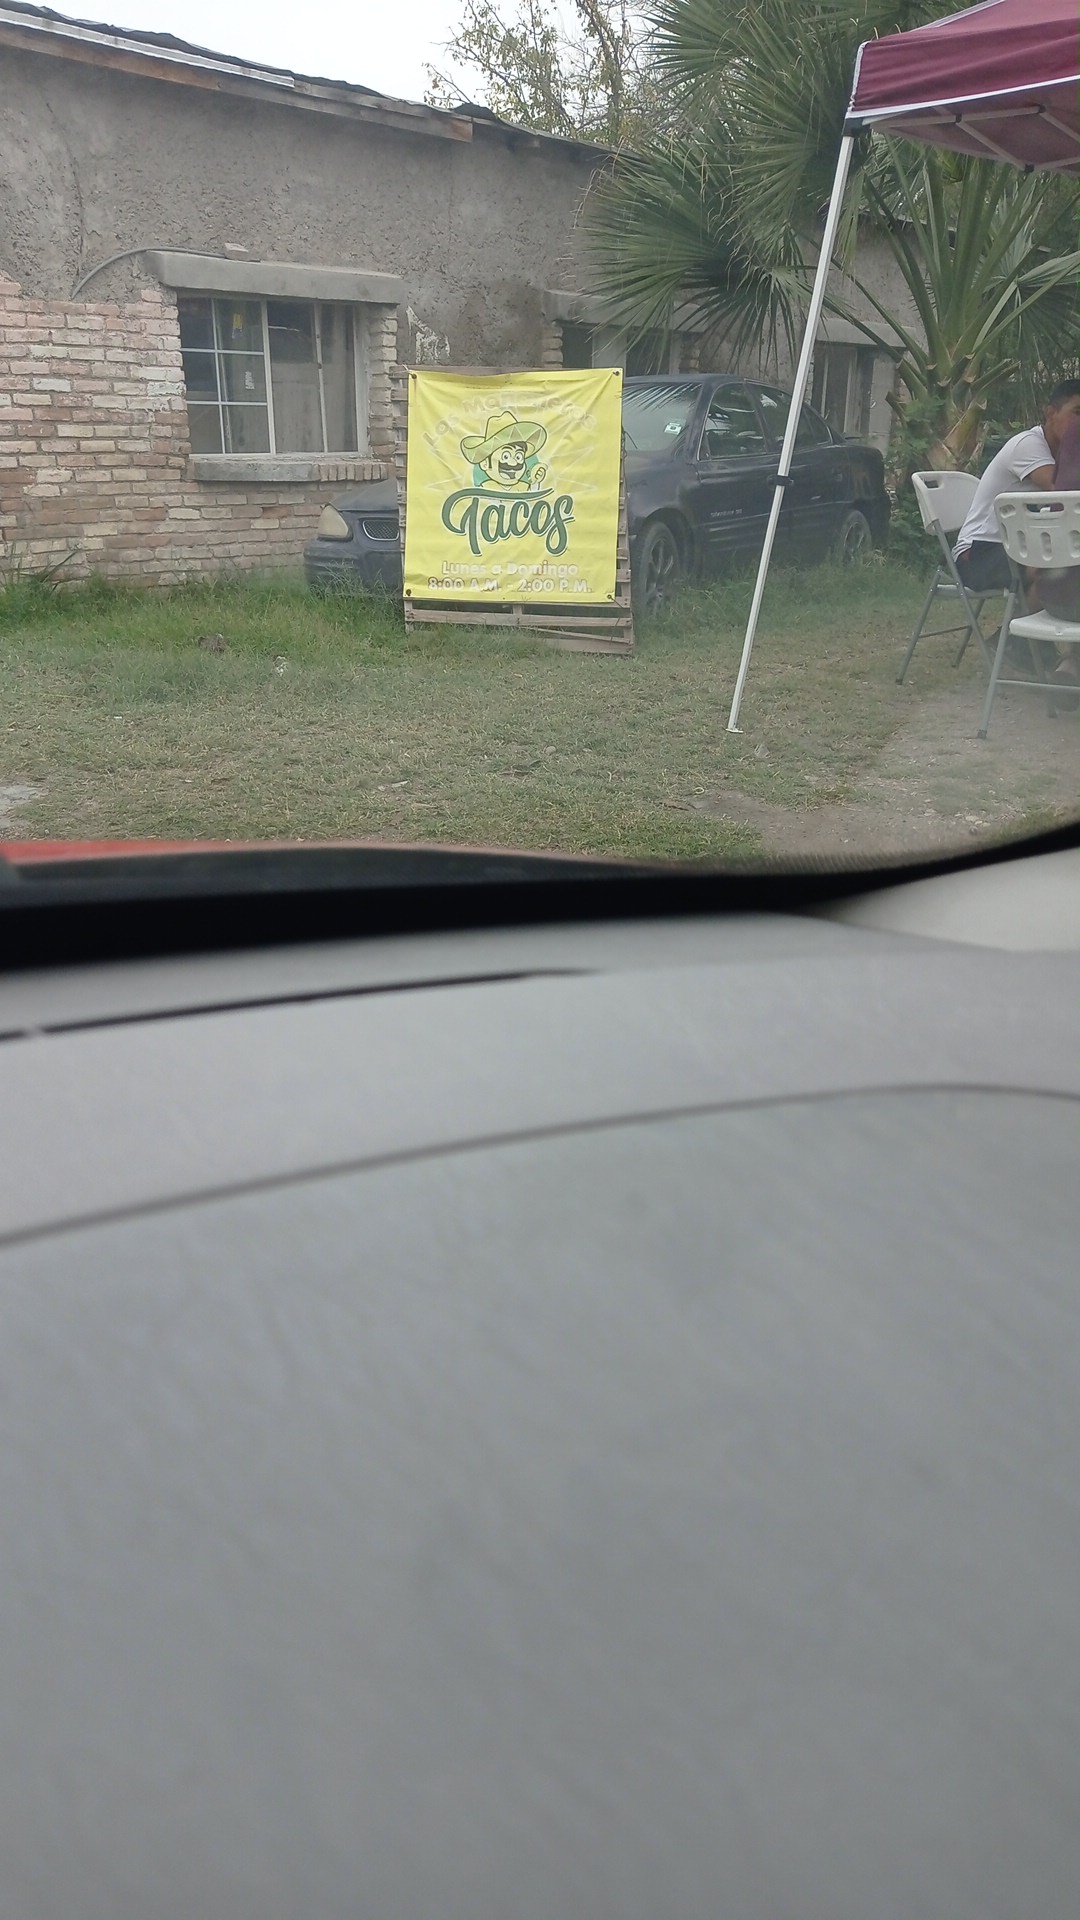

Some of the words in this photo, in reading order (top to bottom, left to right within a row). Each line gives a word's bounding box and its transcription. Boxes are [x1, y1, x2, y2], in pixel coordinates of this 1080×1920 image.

[441, 487, 575, 557] Tacos
[441, 561, 487, 576] Lunes
[491, 565, 503, 576] a
[506, 560, 579, 578] Domingo
[428, 577, 466, 591] 8:00
[469, 578, 502, 592] A.M.
[518, 579, 555, 592] 2:00
[559, 579, 593, 593] P.M.
